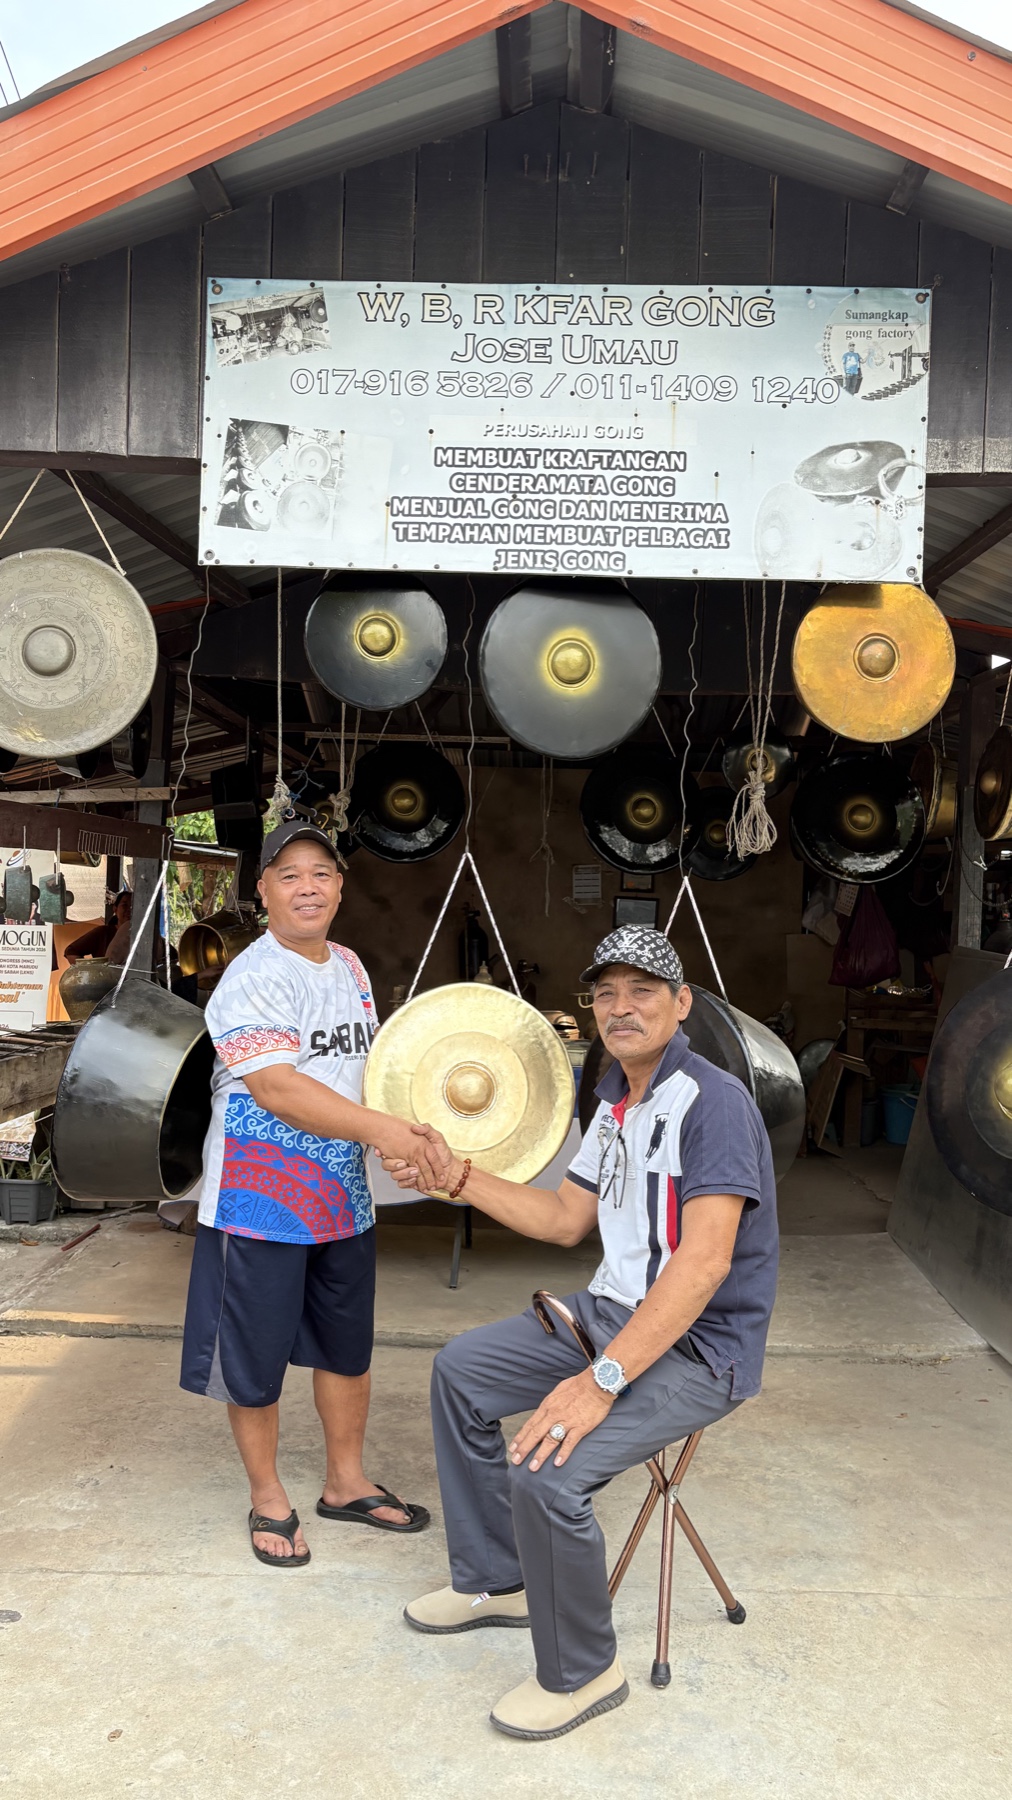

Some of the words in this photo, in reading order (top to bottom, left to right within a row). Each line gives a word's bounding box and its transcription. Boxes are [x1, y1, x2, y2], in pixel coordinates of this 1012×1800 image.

[358, 292, 410, 328] W,
[421, 293, 462, 329] B,
[473, 294, 505, 324] R
[514, 294, 632, 326] KFAR
[641, 295, 775, 327] GONG
[845, 309, 909, 322] Sumangkap
[845, 329, 873, 340] gong
[878, 328, 915, 340] factory
[451, 333, 552, 363] JOSE
[562, 334, 678, 365] UMAU
[290, 368, 429, 396] 017-916
[436, 370, 533, 398] 5826
[574, 374, 738, 403] 011-1409
[752, 376, 840, 405] 1240
[483, 423, 588, 438] PERUSAHAN
[593, 425, 644, 439] GONG
[434, 447, 542, 469] MEMBUAT
[545, 449, 686, 471] KRAFTANGAN
[450, 473, 609, 494] CENDERAMATA
[611, 476, 675, 496] GONG
[391, 498, 490, 519] MENJUAL
[493, 499, 556, 519] GONG
[558, 500, 606, 521] DAN
[611, 501, 729, 523] MENERIMA
[394, 522, 512, 543] TEMPAHAN
[514, 524, 622, 546] MEMBUAT
[624, 527, 730, 549] PELBAGAI
[495, 549, 558, 571] JENIS
[562, 551, 625, 572] GONG
